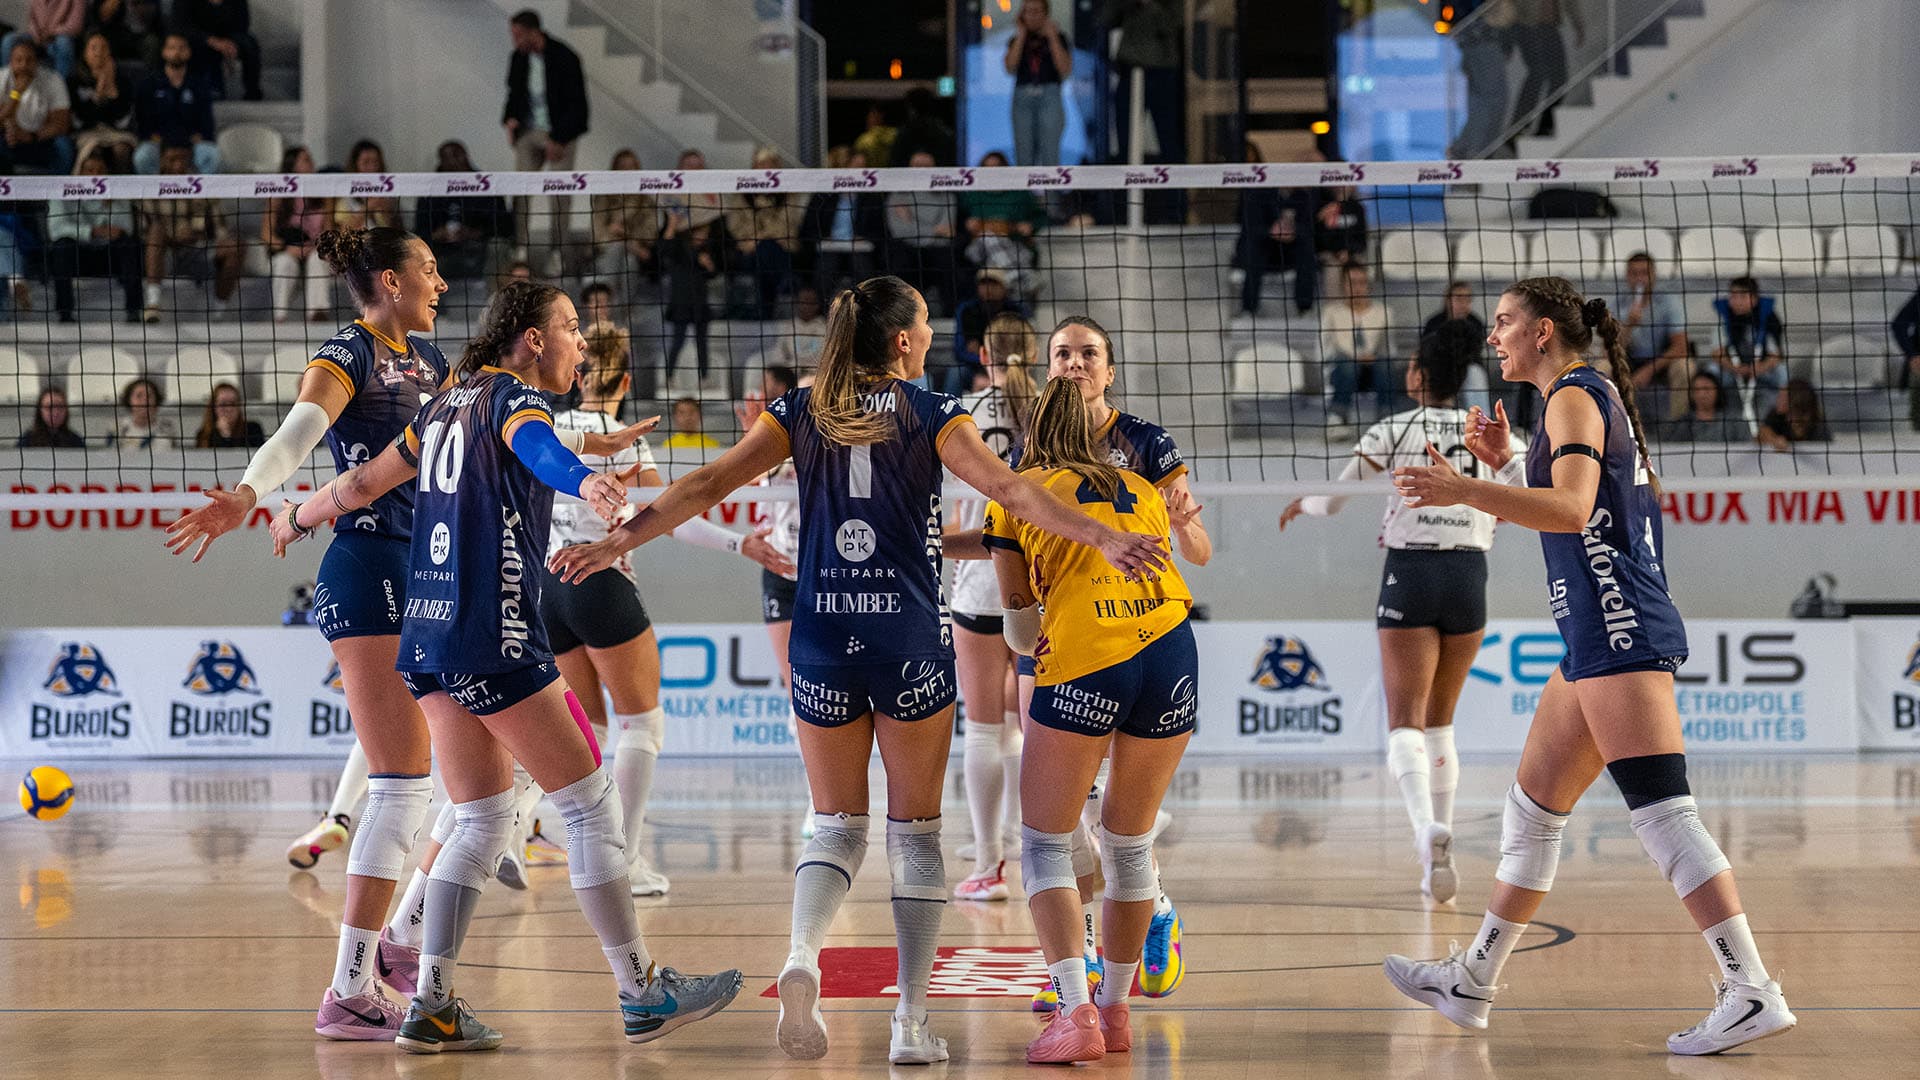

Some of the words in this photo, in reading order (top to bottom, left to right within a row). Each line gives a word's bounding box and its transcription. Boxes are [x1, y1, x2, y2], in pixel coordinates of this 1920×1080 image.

[419, 420, 464, 493] 10
[1075, 475, 1138, 514] 4
[844, 529, 868, 539] MT
[1417, 514, 1471, 527] Mulhouse
[434, 531, 448, 543] MT
[844, 542, 869, 553] PK
[433, 545, 447, 557] PK
[819, 568, 896, 578] METPARK
[1581, 507, 1639, 652] Saforelle
[383, 579, 397, 613] CRAFT
[404, 598, 454, 621] HUMBEE
[814, 592, 902, 614] HUMBEE
[1094, 598, 1166, 618] HUMB
[314, 603, 339, 625] MFT
[793, 667, 849, 704] interim
[896, 670, 946, 708] CMFT
[1053, 683, 1121, 713] nterim
[794, 687, 848, 716] nation
[1051, 697, 1115, 725] nation
[1159, 695, 1196, 725] CMFT
[1677, 688, 1806, 715] ÉTROPOLE
[31, 702, 131, 740] BURDIS
[170, 701, 272, 740] BURDIS
[1239, 697, 1342, 735] BURDIS
[1085, 913, 1093, 937] CRAFT
[1484, 927, 1500, 953] CRAFT
[1715, 937, 1736, 963] CRAFT
[354, 941, 366, 968] CRAFT
[629, 951, 643, 978] CRAFT
[432, 965, 442, 990] CRAFT
[1052, 975, 1066, 1001] CRAFT
